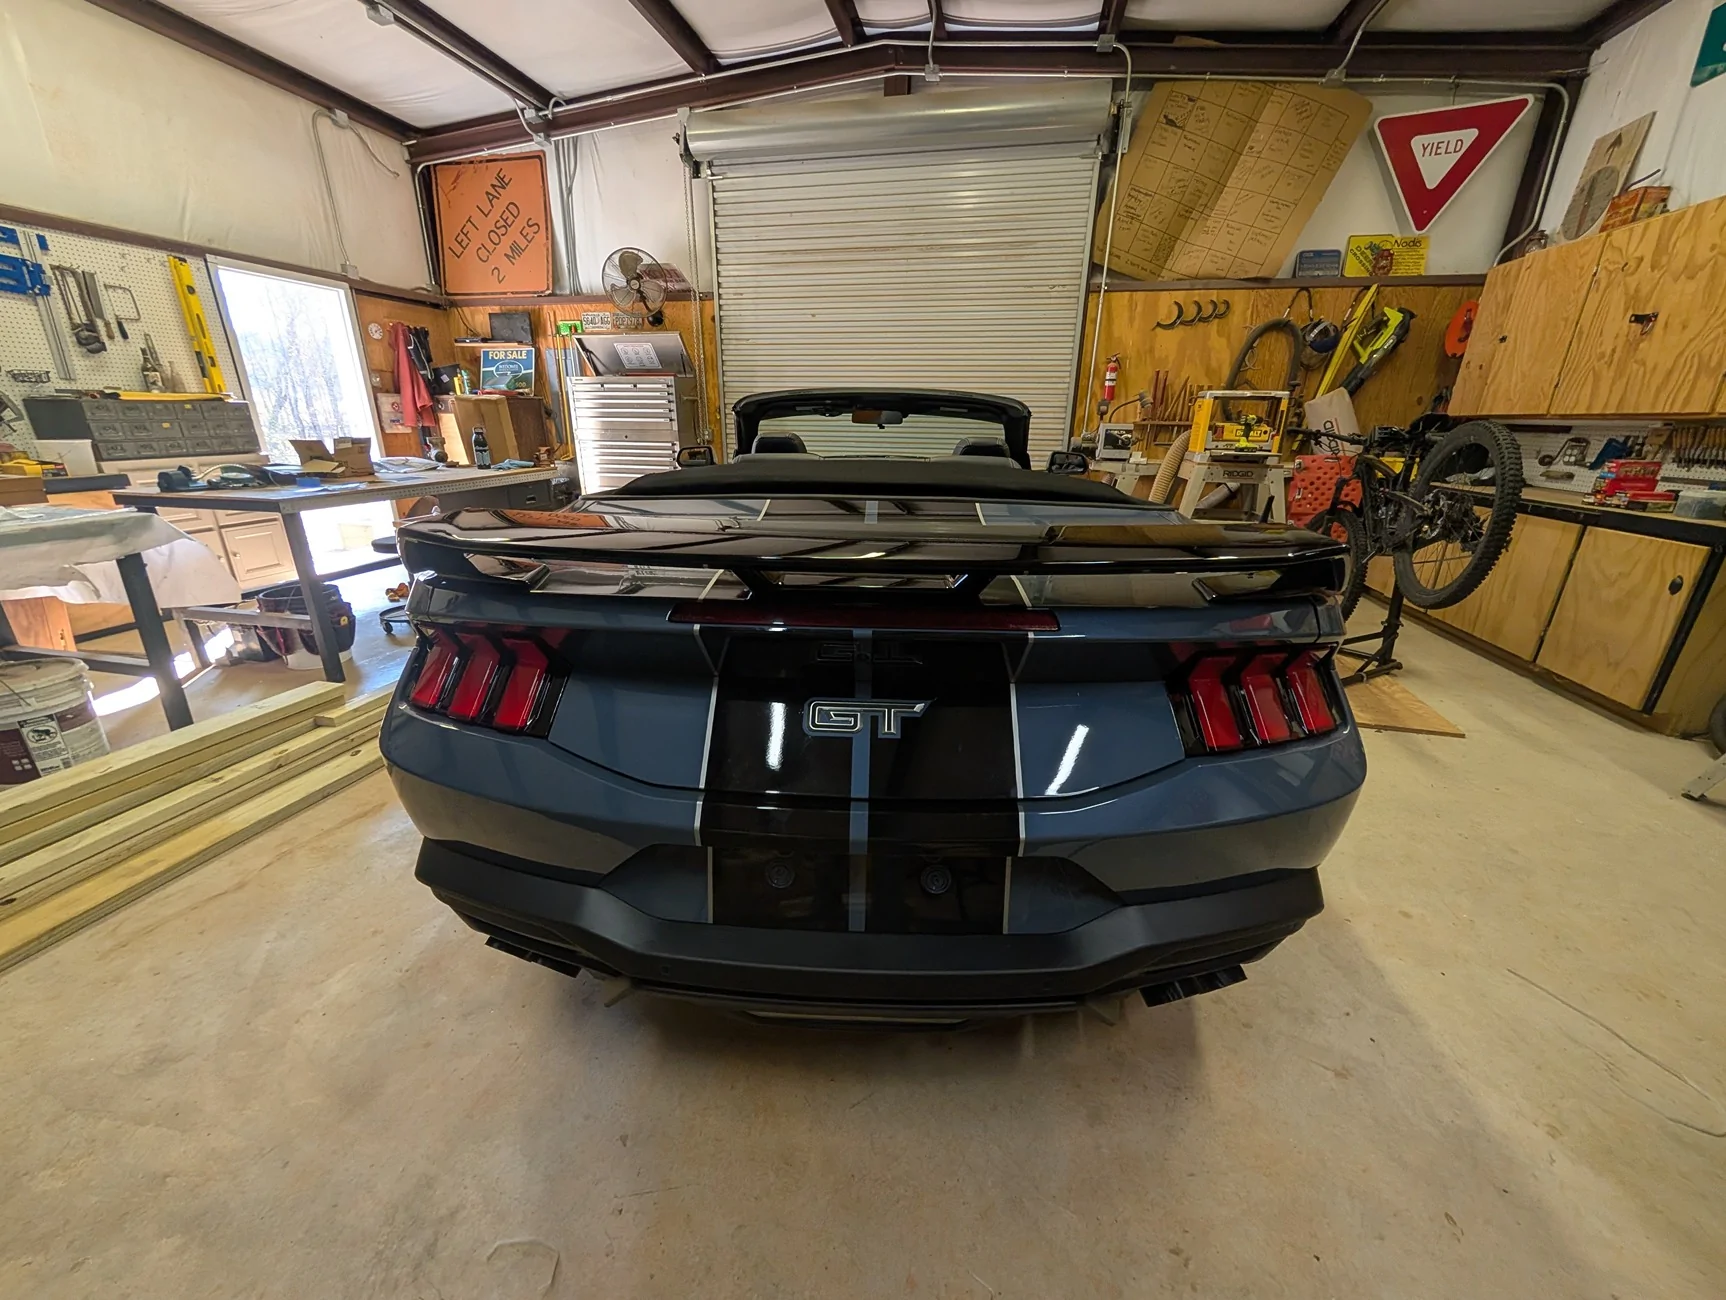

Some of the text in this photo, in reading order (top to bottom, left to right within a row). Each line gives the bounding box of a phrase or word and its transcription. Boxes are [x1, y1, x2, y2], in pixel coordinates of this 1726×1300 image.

[1421, 138, 1464, 157] YIELD
[448, 168, 512, 259] LEFT LANE
[476, 201, 520, 263] CLOSED
[491, 217, 540, 284] 2 MILES
[1349, 248, 1374, 277] CROSSING
[488, 350, 528, 360] FOR SALE
[1236, 429, 1262, 437] DEALT
[1222, 469, 1254, 478] RIDGID
[806, 699, 927, 735] GT
